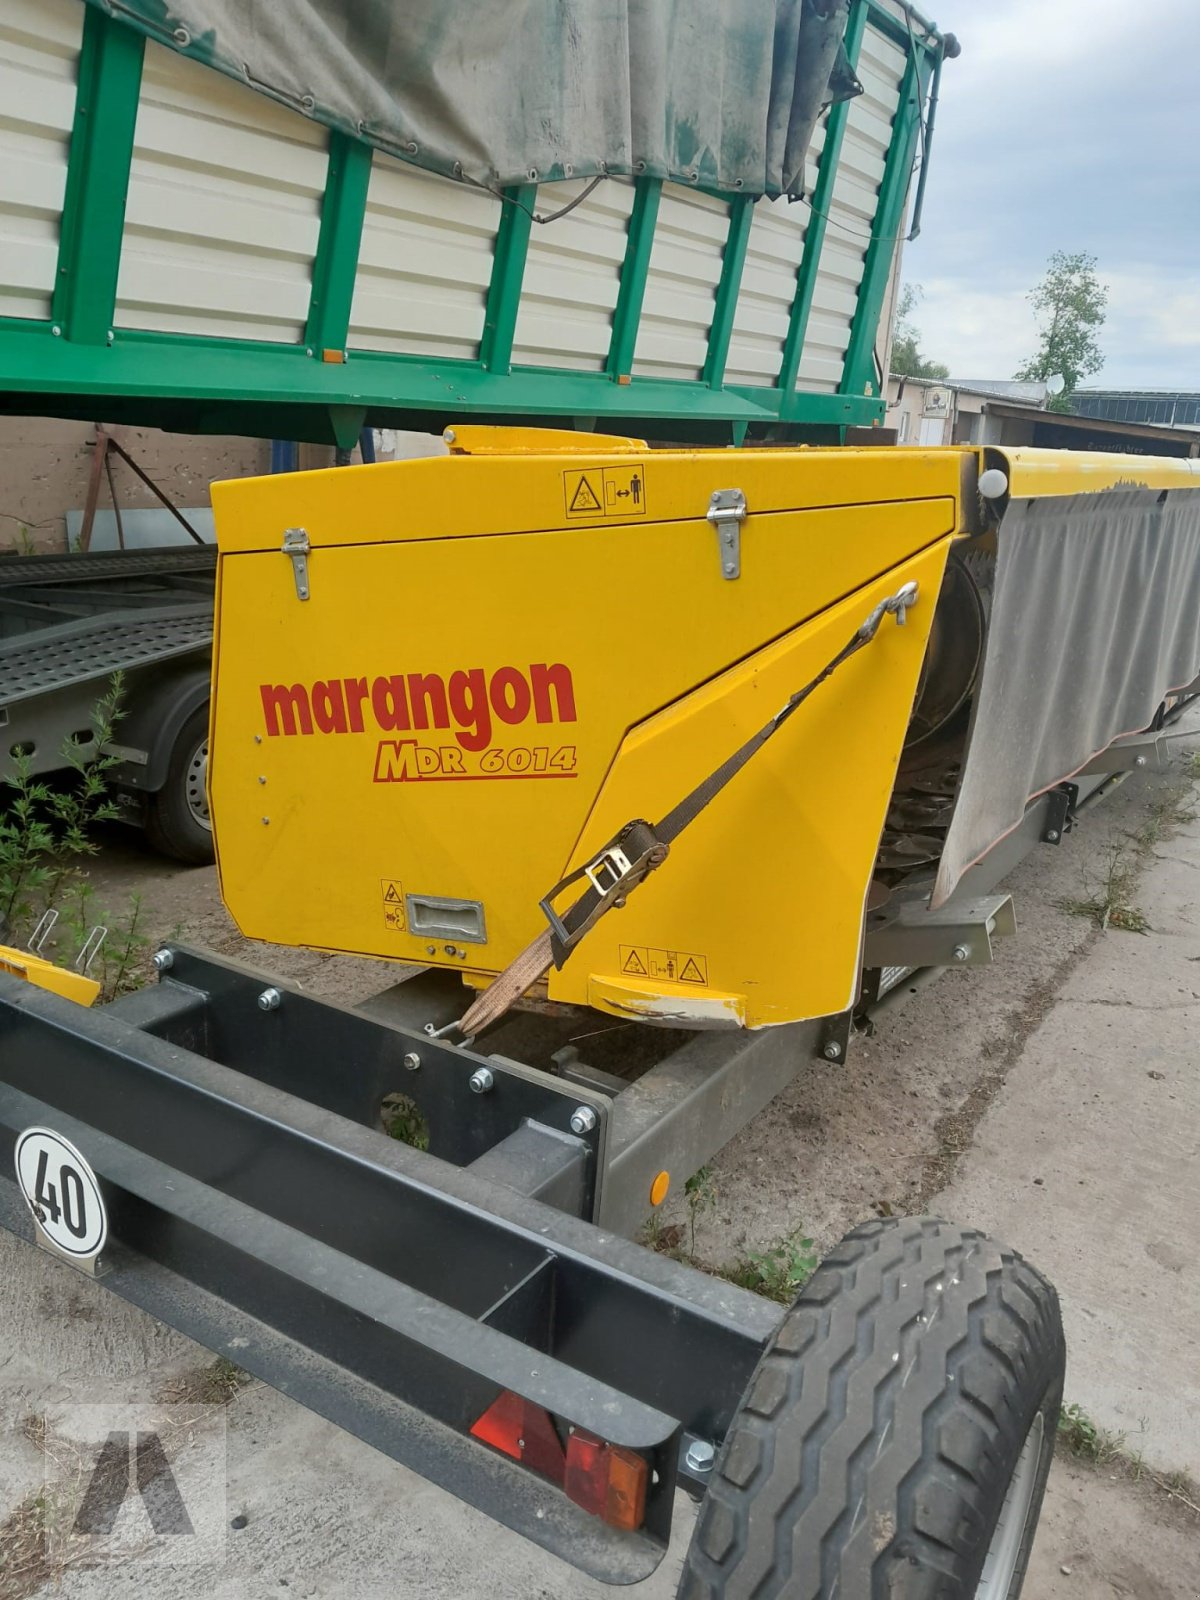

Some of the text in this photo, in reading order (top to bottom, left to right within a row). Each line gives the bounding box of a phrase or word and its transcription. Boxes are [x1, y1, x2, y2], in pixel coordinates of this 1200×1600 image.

[260, 663, 577, 752] marangon
[373, 739, 577, 782] MDR 6014
[35, 1149, 87, 1239] 40
